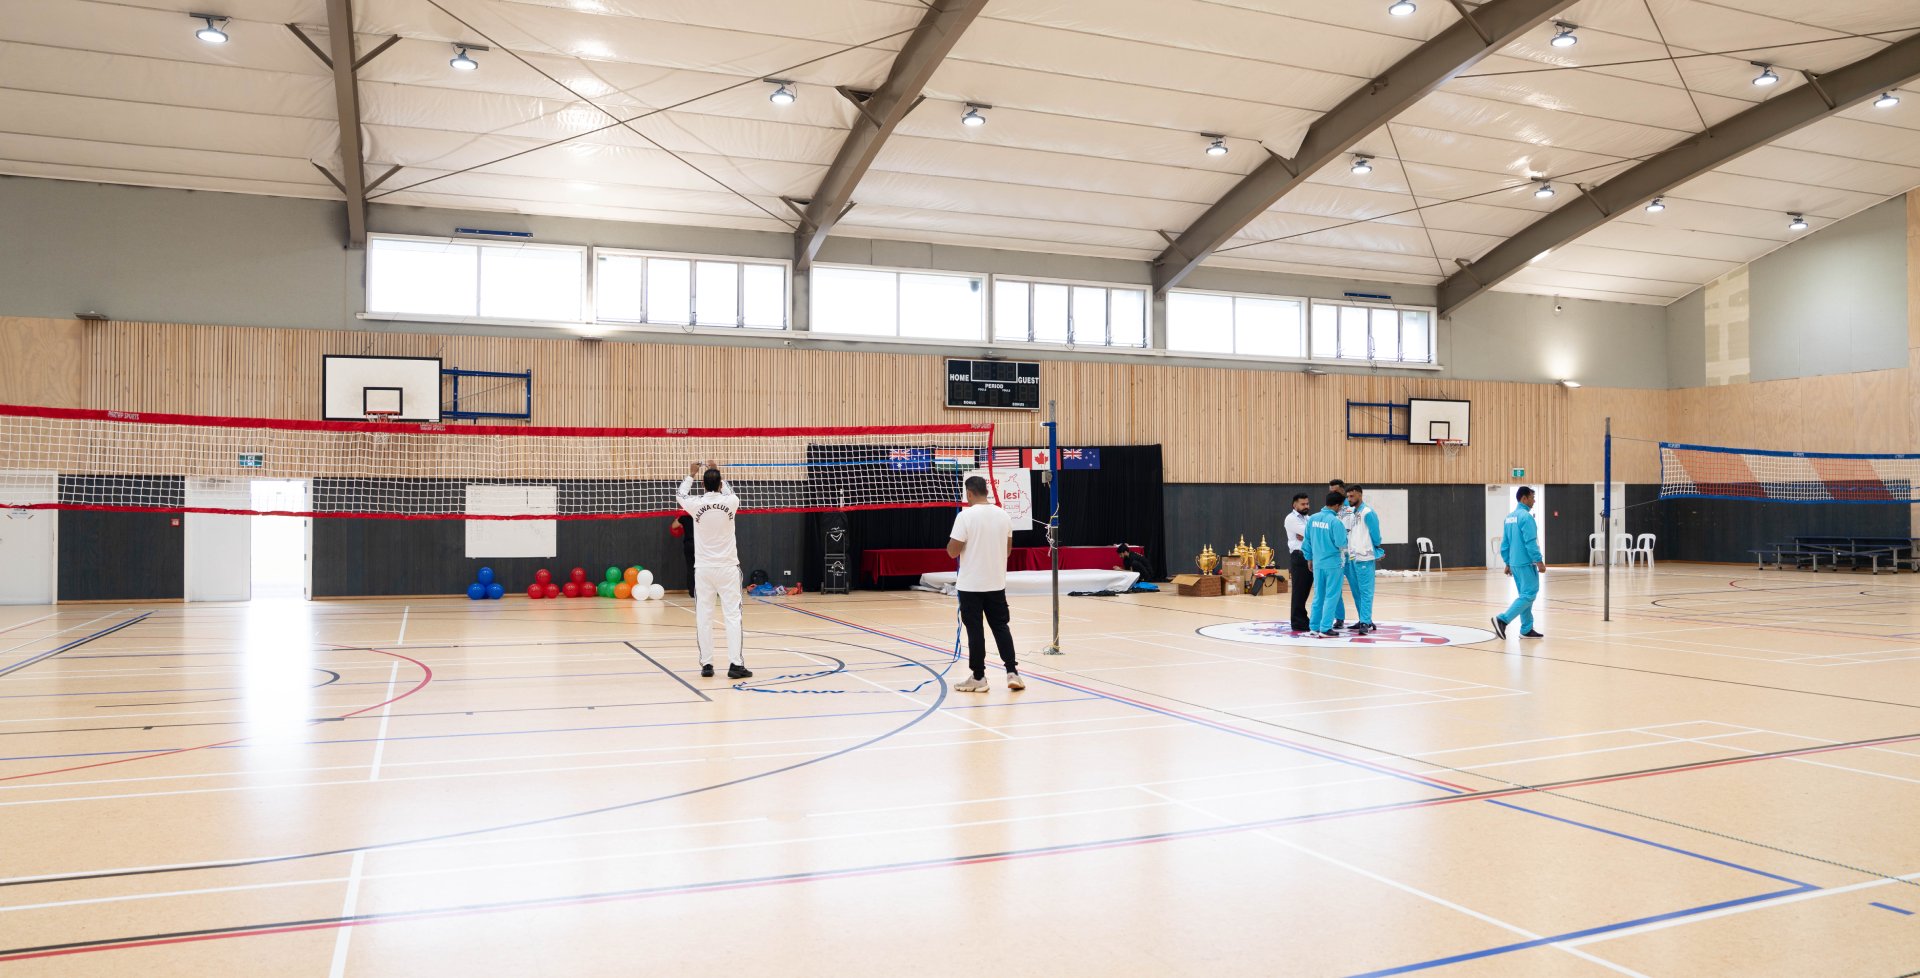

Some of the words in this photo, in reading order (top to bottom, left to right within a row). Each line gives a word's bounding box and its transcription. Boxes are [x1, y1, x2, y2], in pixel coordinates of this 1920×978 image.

[949, 374, 970, 382] HOME
[1018, 376, 1039, 384] GUEST
[712, 503, 729, 513] CLUB
[1312, 521, 1329, 529] INDIA
